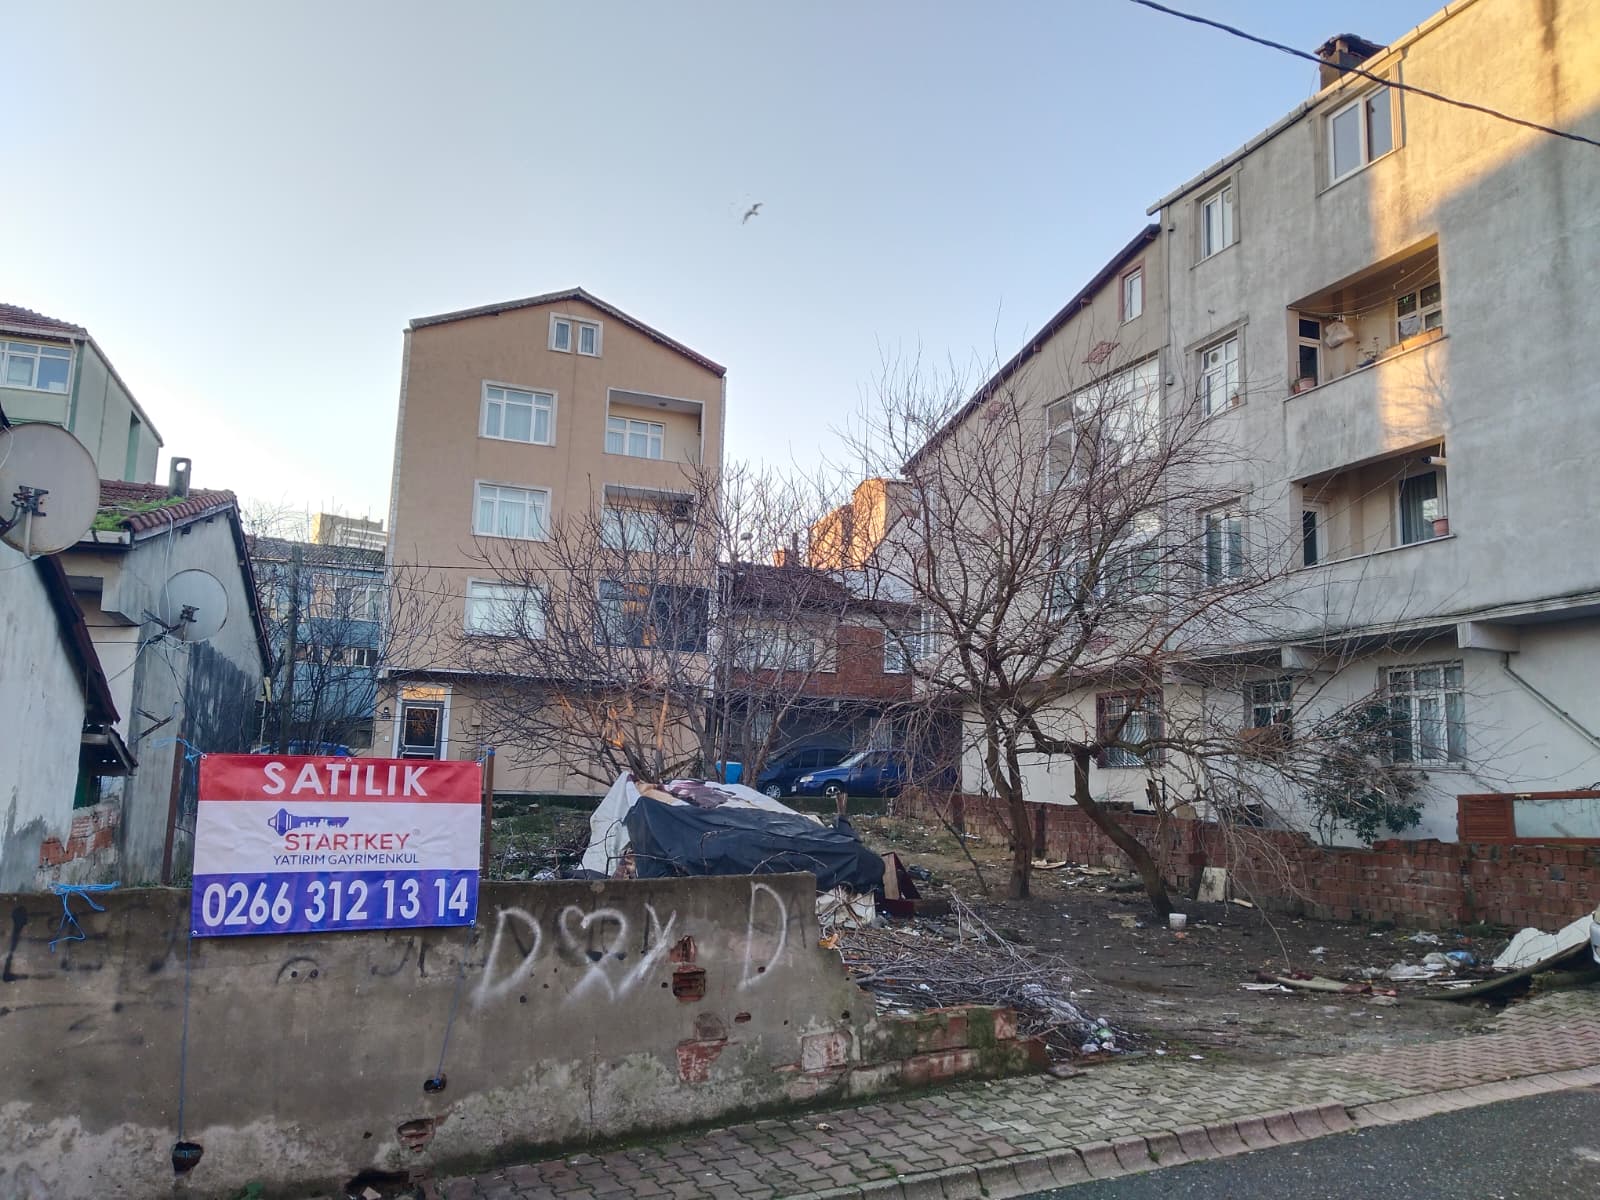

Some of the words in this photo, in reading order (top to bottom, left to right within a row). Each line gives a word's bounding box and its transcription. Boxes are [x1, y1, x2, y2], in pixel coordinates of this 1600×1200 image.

[262, 762, 428, 796] SATILIK
[285, 833, 410, 851] STARTKEY
[273, 854, 325, 865] YATIRIM
[328, 852, 418, 865] GAYRİMENKUL
[202, 881, 292, 927] 0266
[305, 880, 367, 922] 312
[383, 878, 420, 920] 13
[434, 878, 469, 917] 14
